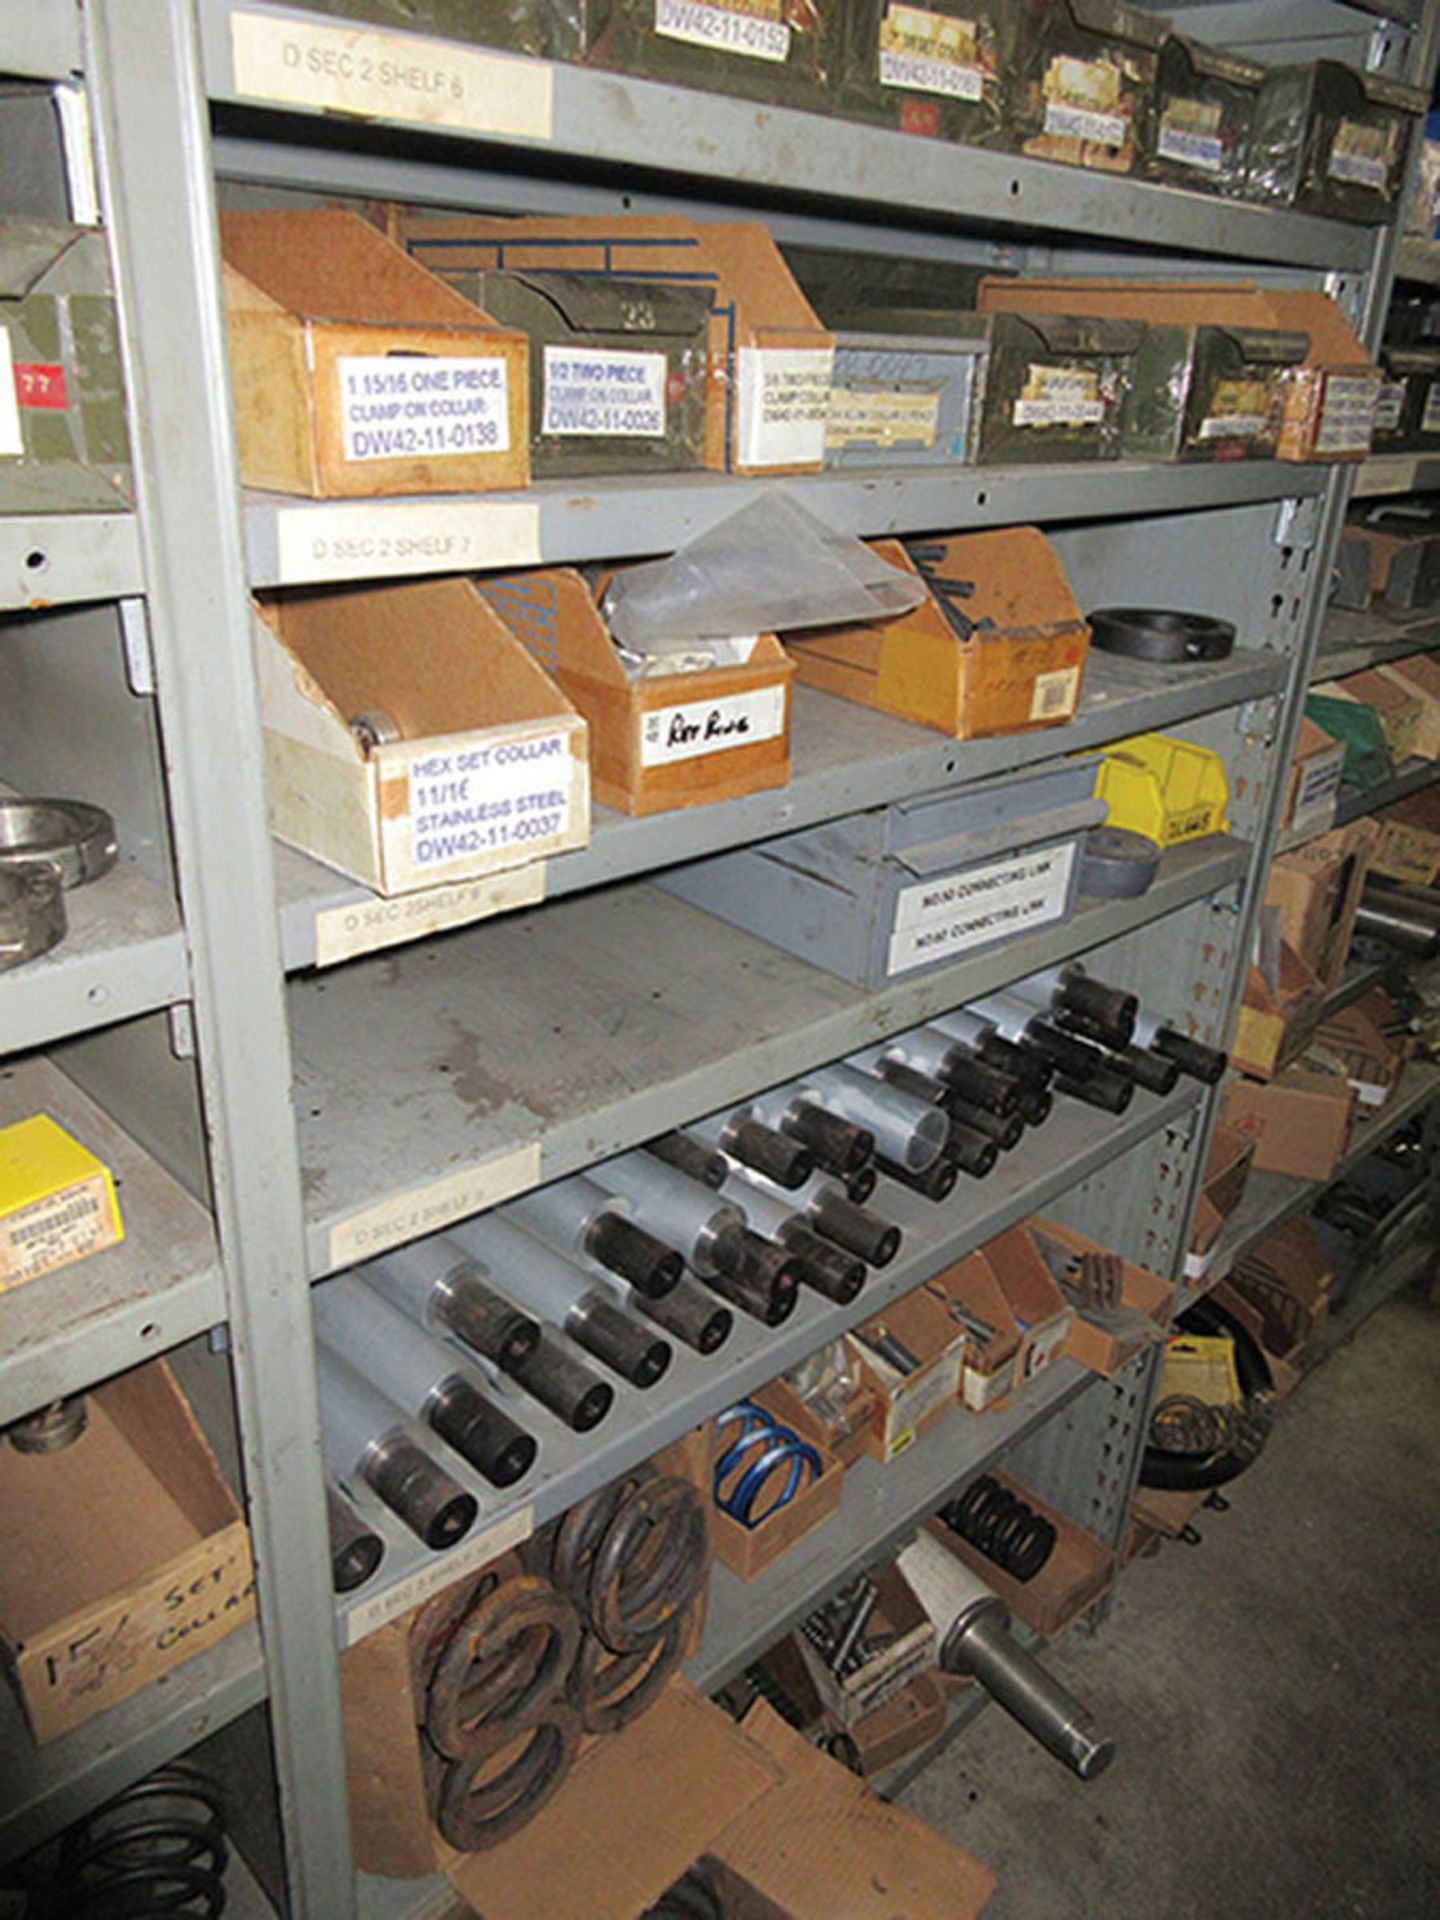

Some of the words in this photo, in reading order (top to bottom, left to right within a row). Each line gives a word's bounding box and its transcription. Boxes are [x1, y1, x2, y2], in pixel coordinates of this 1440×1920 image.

[283, 43, 300, 68] D
[307, 47, 353, 80] SEC
[360, 58, 373, 82] 2
[379, 61, 447, 94] SHELF
[347, 375, 357, 395] 1
[363, 372, 408, 395] 15/16
[411, 370, 449, 392] ONE
[453, 368, 502, 390] PIECE
[572, 362, 604, 381] TWO
[606, 364, 646, 384] PIECE
[349, 402, 402, 423] CLAMP
[404, 401, 428, 419] ON
[429, 397, 487, 418] COLLAR
[548, 407, 661, 430] DW42-11-0026
[351, 420, 499, 458] DW42-11-0138
[312, 537, 327, 559] D
[333, 537, 374, 559] SEC
[379, 538, 391, 558] 2
[395, 535, 458, 558] SHELF
[413, 757, 452, 778] HEX
[456, 749, 491, 773] SET
[494, 738, 562, 766] COLLAR
[416, 799, 512, 834] STAINLESS
[515, 789, 567, 814] STEEL
[416, 812, 562, 863] DW42-11-0037
